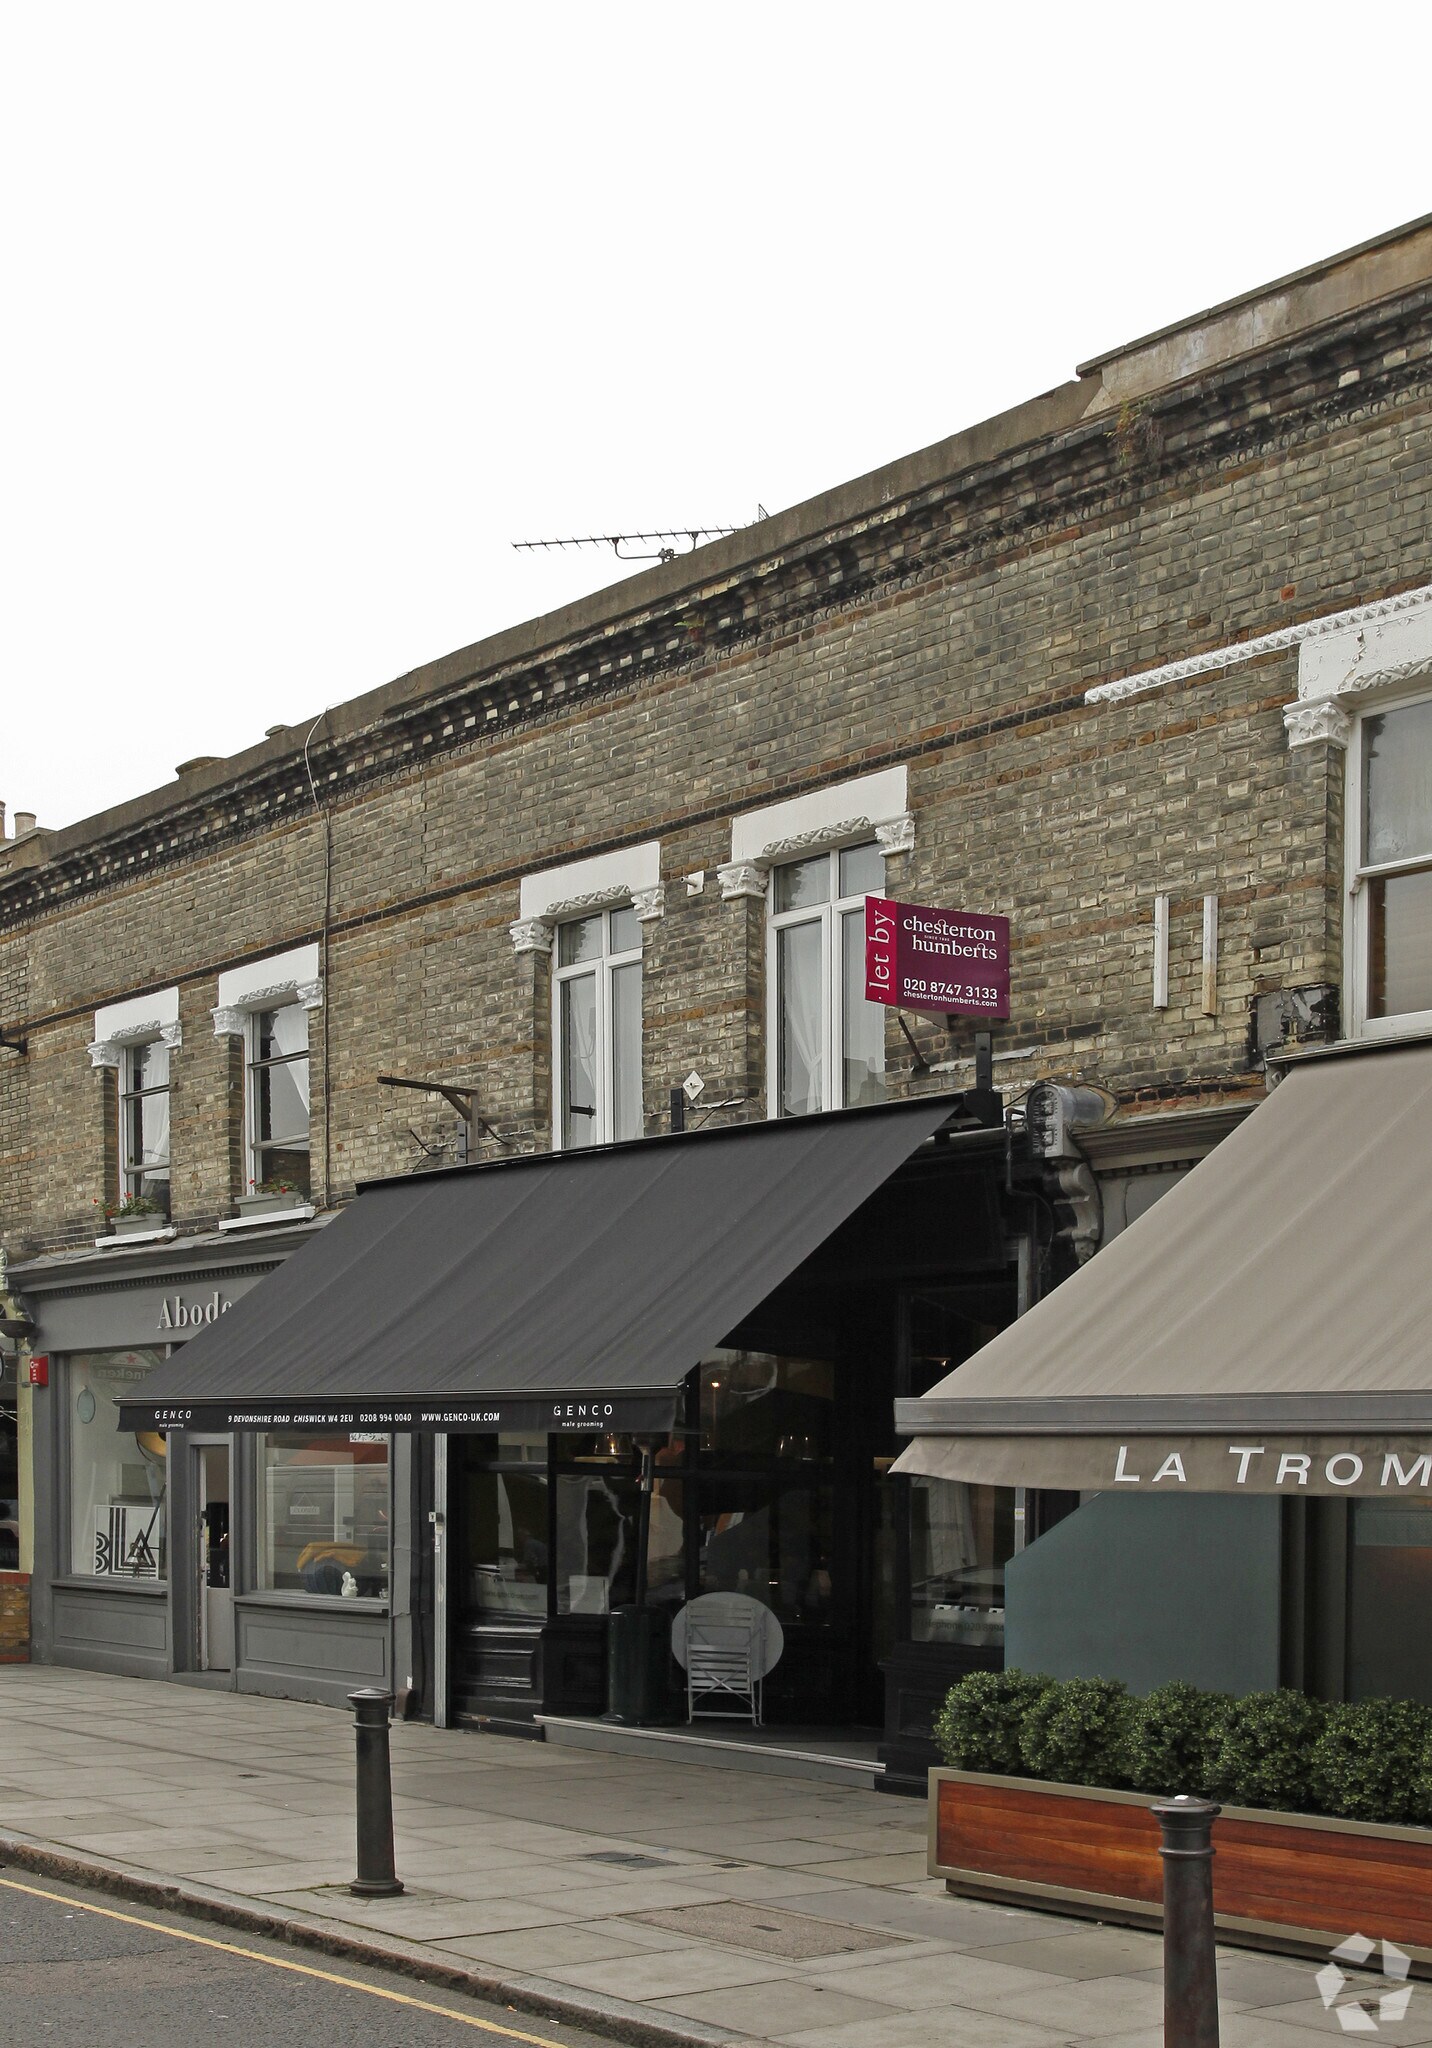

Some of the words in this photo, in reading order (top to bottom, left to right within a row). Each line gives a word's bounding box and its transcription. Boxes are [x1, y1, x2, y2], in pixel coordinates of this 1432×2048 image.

[868, 910, 895, 944] by
[903, 916, 996, 942] chesterton
[912, 935, 998, 960] humberts
[869, 954, 890, 990] let
[903, 978, 926, 991] 020
[930, 981, 961, 996] 8747
[965, 986, 998, 999] 3133
[903, 990, 998, 1007] chestertonhumberts.com
[154, 1410, 192, 1419] GENCO
[227, 1415, 232, 1423] 9
[233, 1415, 272, 1423] DEVONSHIRE
[273, 1415, 290, 1423] ROAD
[293, 1414, 326, 1423] CHISWICK
[328, 1414, 338, 1423] W4
[340, 1414, 354, 1423] 2EU
[359, 1413, 378, 1422] 0208
[379, 1413, 393, 1422] 994
[394, 1413, 412, 1422] 0040
[421, 1412, 500, 1422] WWW.GENCO-UK.COM
[553, 1404, 613, 1416] GENCO
[577, 1420, 604, 1428] grooming
[1114, 1445, 1187, 1482] LA
[1228, 1446, 1432, 1487] TROM
